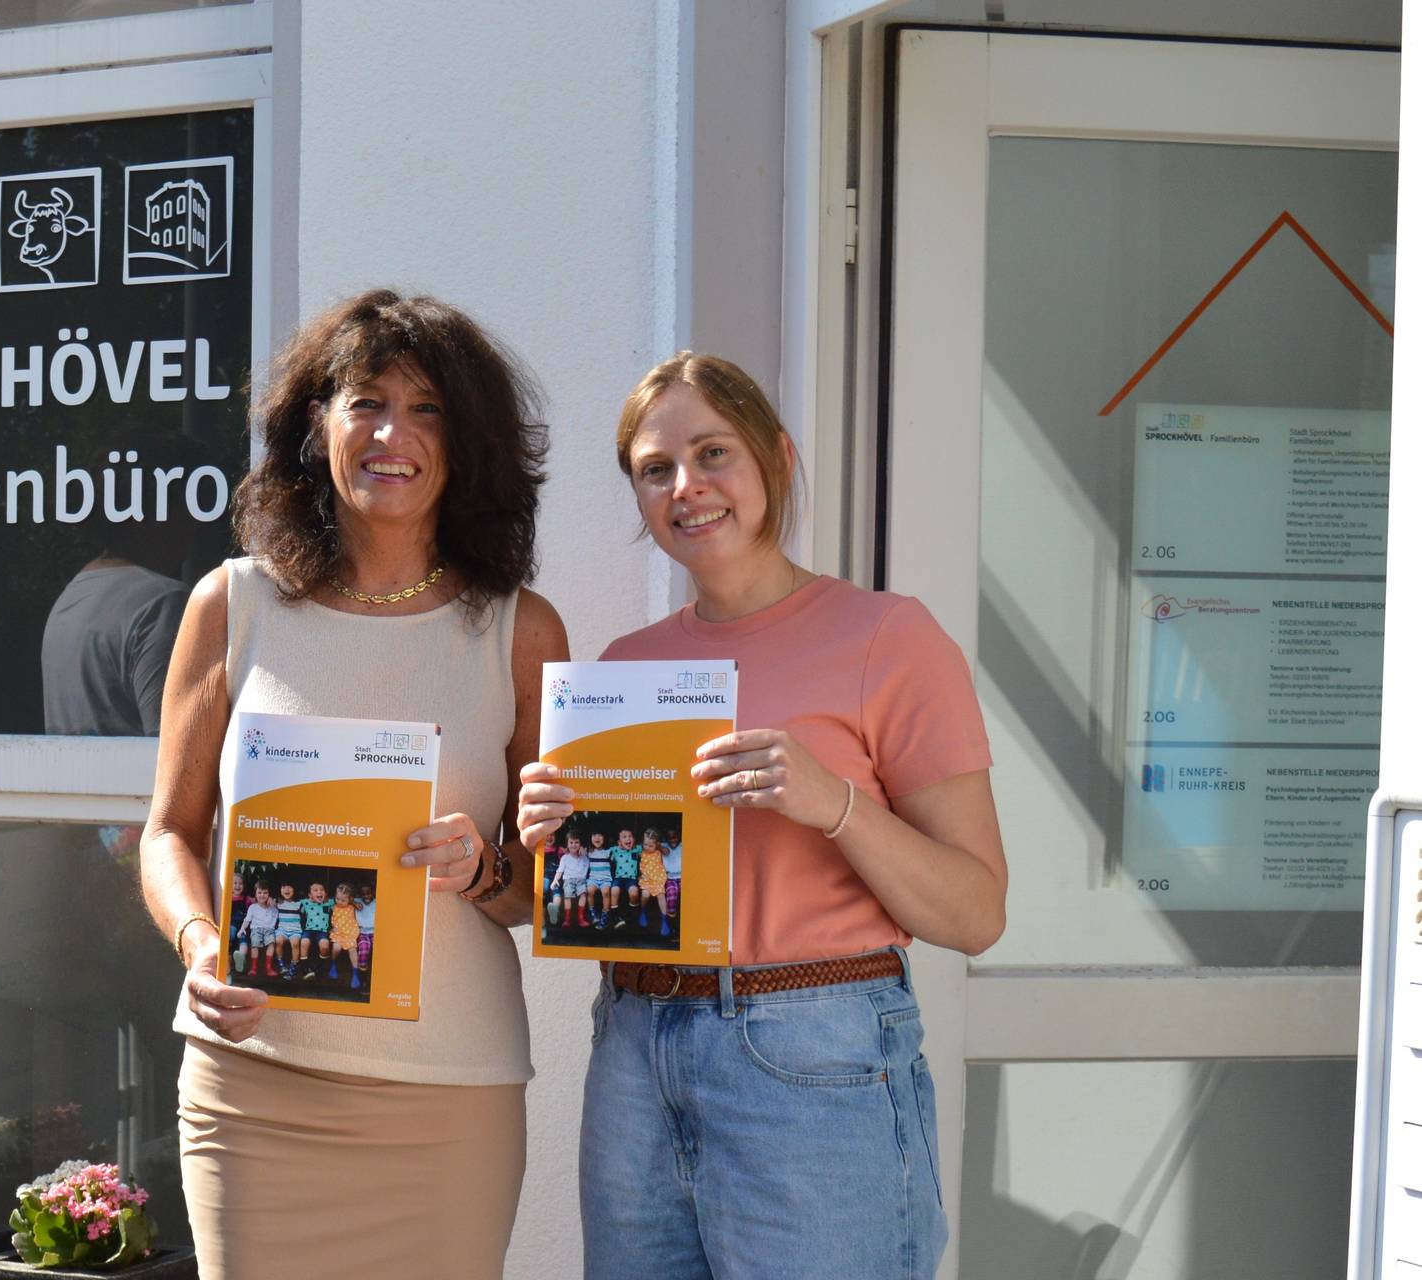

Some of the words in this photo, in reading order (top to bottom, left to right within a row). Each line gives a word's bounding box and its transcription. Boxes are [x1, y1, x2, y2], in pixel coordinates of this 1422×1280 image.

[1145, 431, 1203, 442] SPROCKHÖVEL
[1210, 434, 1260, 445] Familienbüro
[1141, 546, 1153, 558] 2.
[1156, 546, 1176, 559] OG
[1198, 606, 1261, 614] Beratungszentrum
[1272, 600, 1330, 609] NEBENSTELLE
[571, 694, 624, 705] kinderstark
[657, 693, 726, 704] SPROCKHÖVEL
[1143, 711, 1175, 724] 2.OG
[265, 746, 320, 759] kinderstark
[354, 753, 426, 766] SPROCKHÖVEL
[556, 765, 677, 783] milienwegweiser
[1179, 767, 1228, 777] ENNEPE-
[1266, 768, 1324, 777] NEBENSTELLE
[1178, 780, 1246, 791] RUHR-KREIS
[634, 791, 684, 801] Unterstützung
[237, 815, 374, 837] Familienwegweiser
[235, 840, 259, 850] Geburt
[262, 843, 322, 855] Kinderbetreuung
[327, 847, 379, 859] Unterstützung
[1137, 879, 1170, 891] 2.OG
